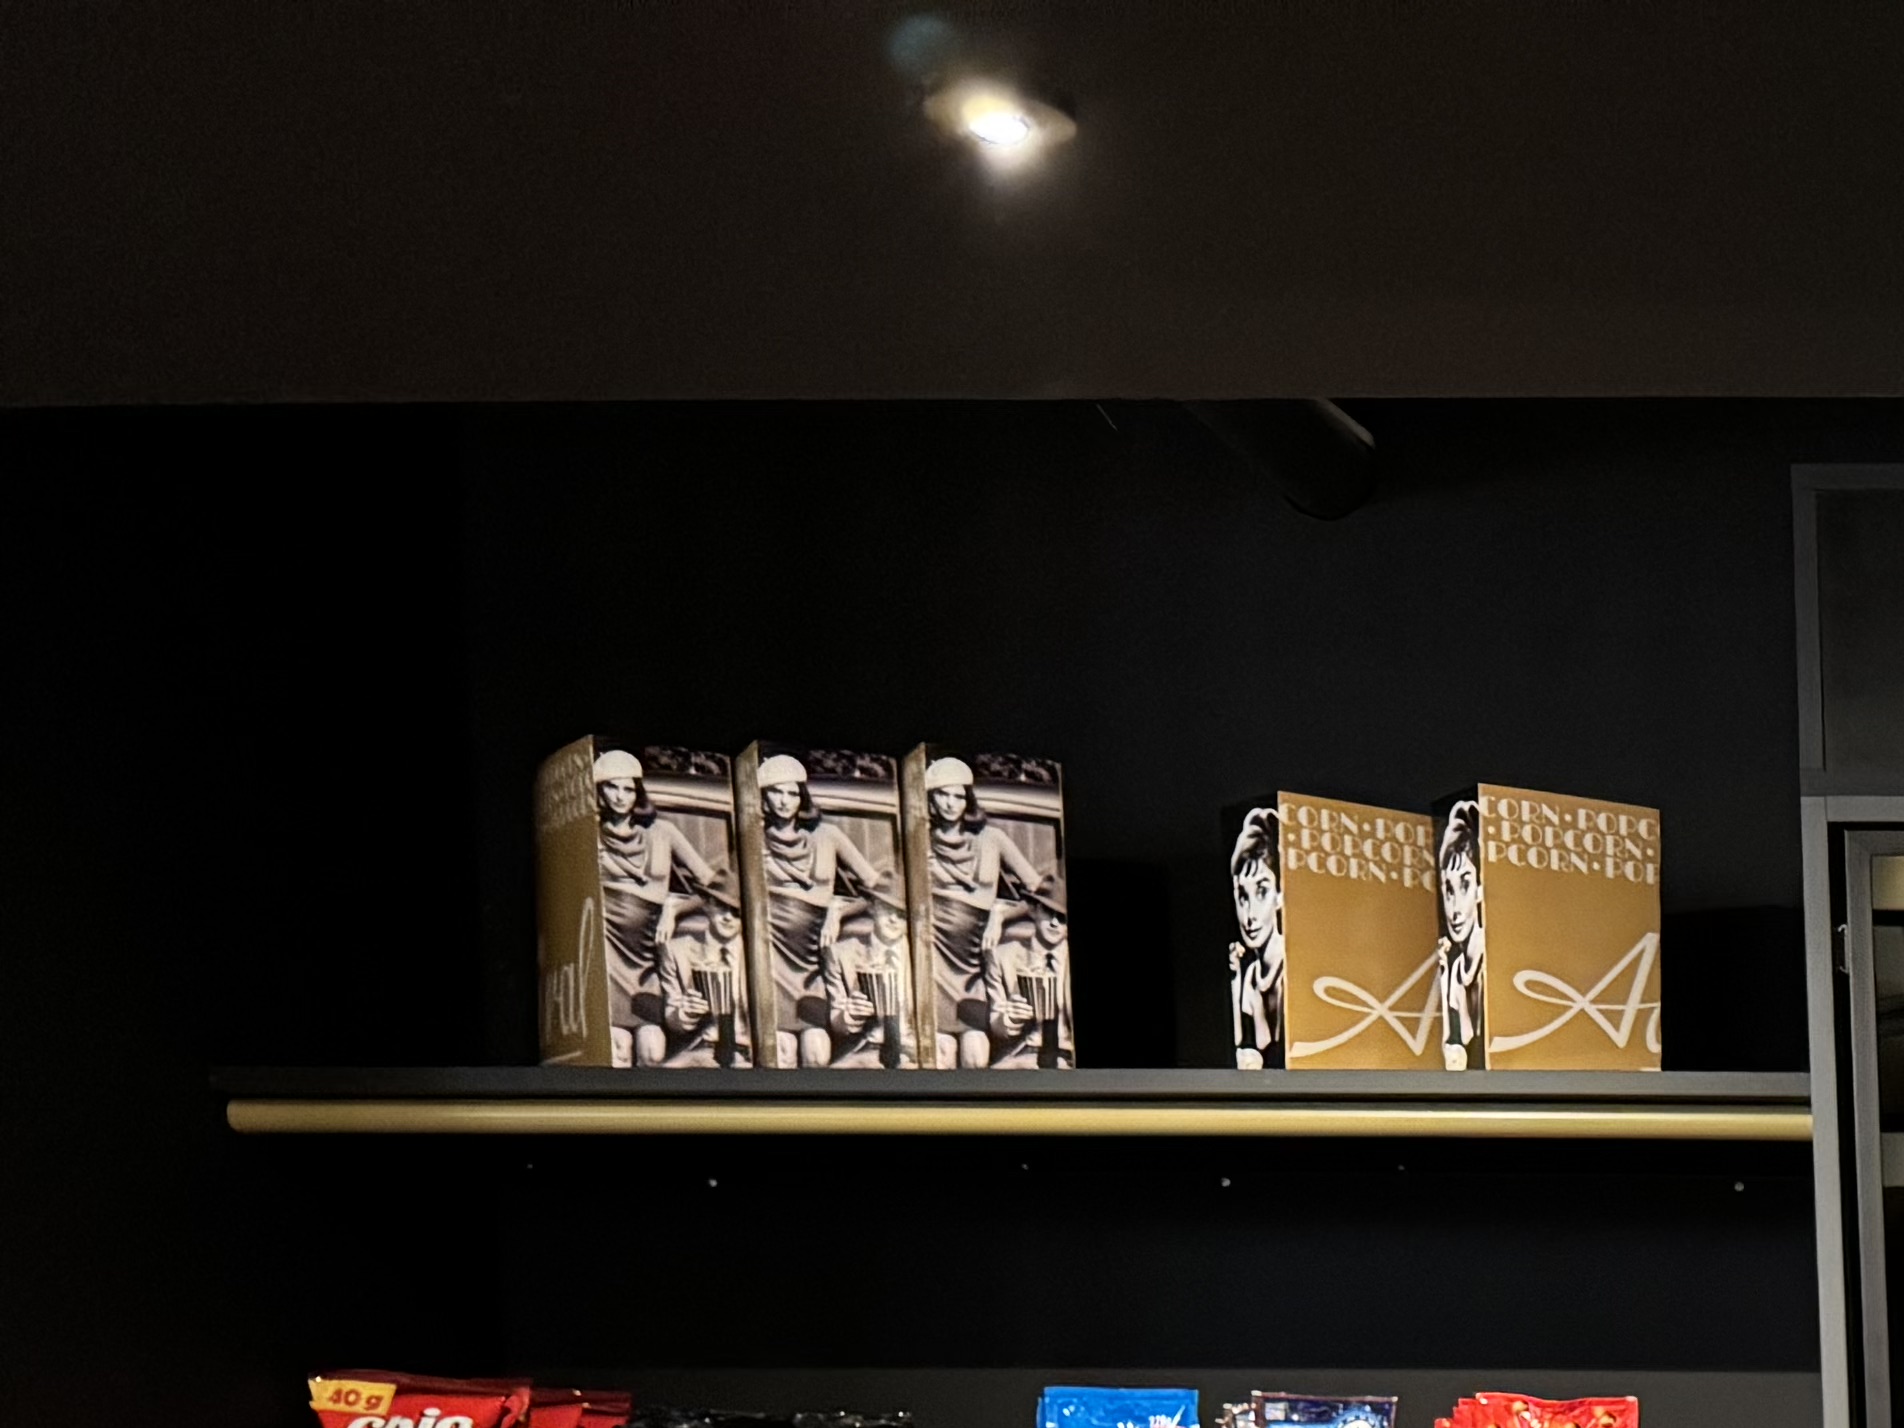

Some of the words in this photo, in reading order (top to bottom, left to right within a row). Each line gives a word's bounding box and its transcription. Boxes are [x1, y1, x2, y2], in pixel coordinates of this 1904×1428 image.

[1501, 820, 1643, 861] POPCORN
[327, 1387, 362, 1406] 40
[365, 1393, 384, 1412] g
